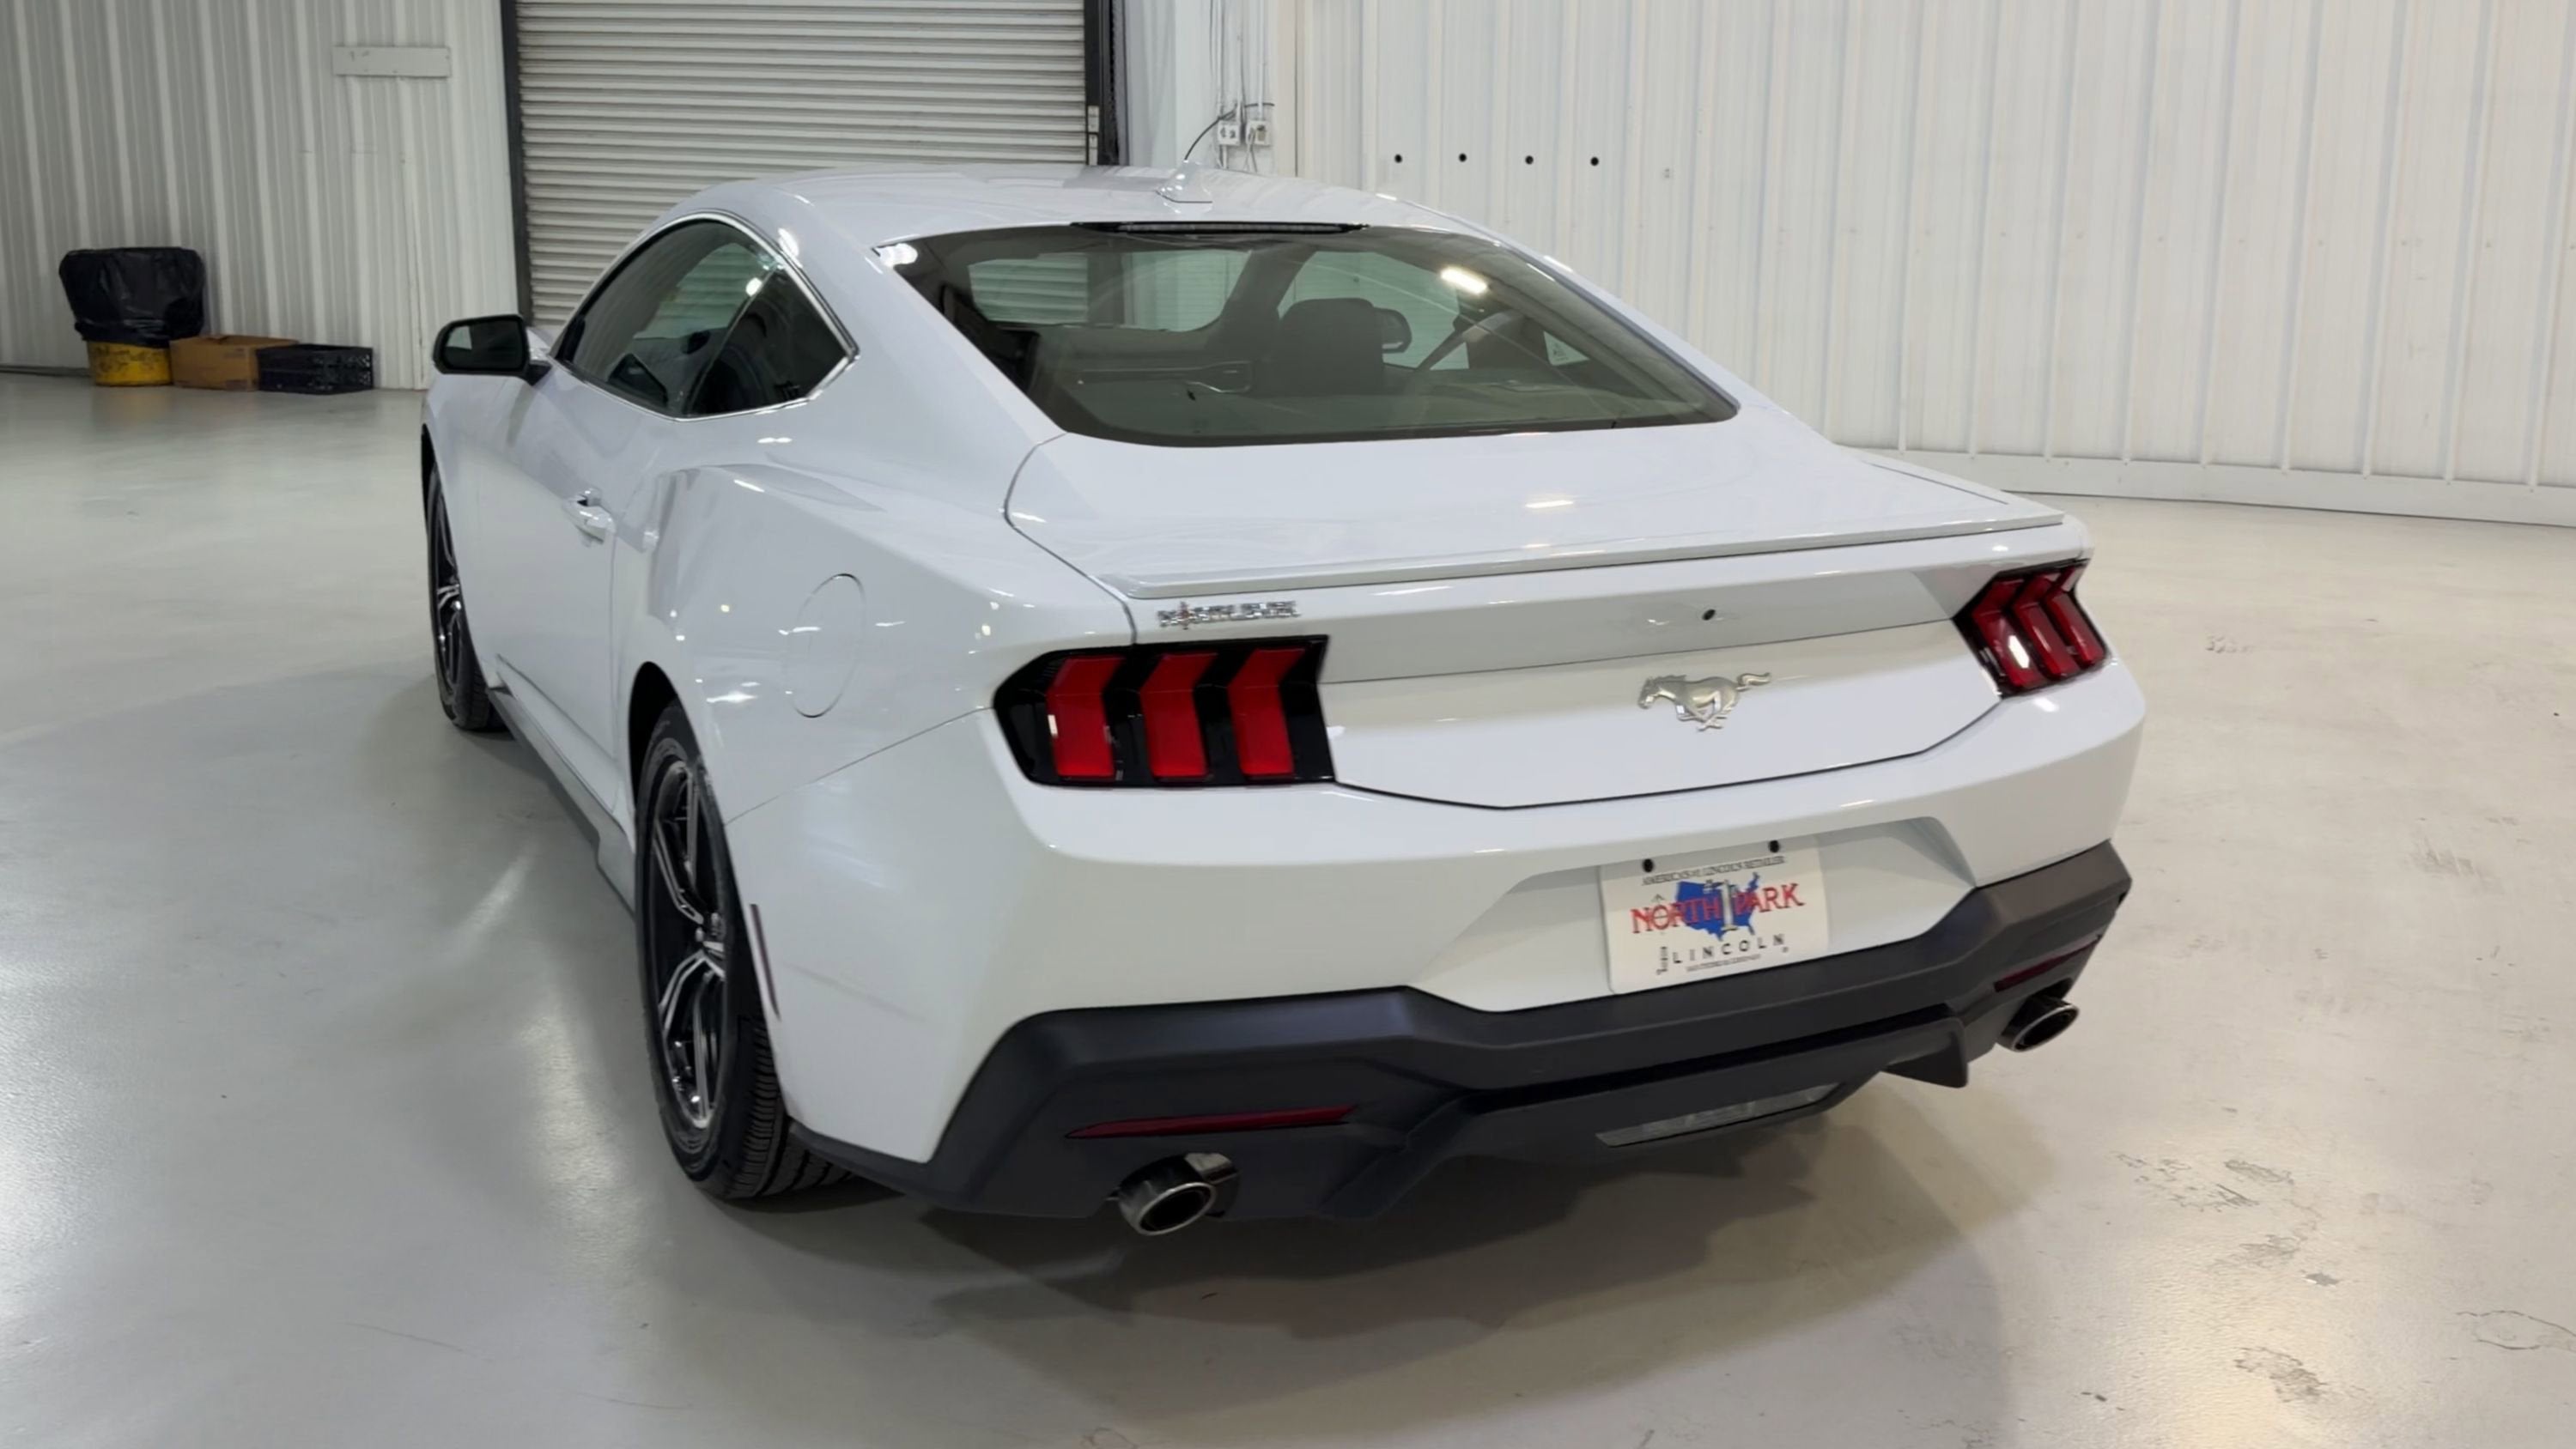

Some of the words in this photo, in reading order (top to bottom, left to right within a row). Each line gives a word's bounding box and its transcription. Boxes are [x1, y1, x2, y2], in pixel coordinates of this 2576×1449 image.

[1630, 897, 1722, 933] NORTH
[1733, 882, 1805, 915] PARK
[1673, 934, 1784, 963] LINCOLN
